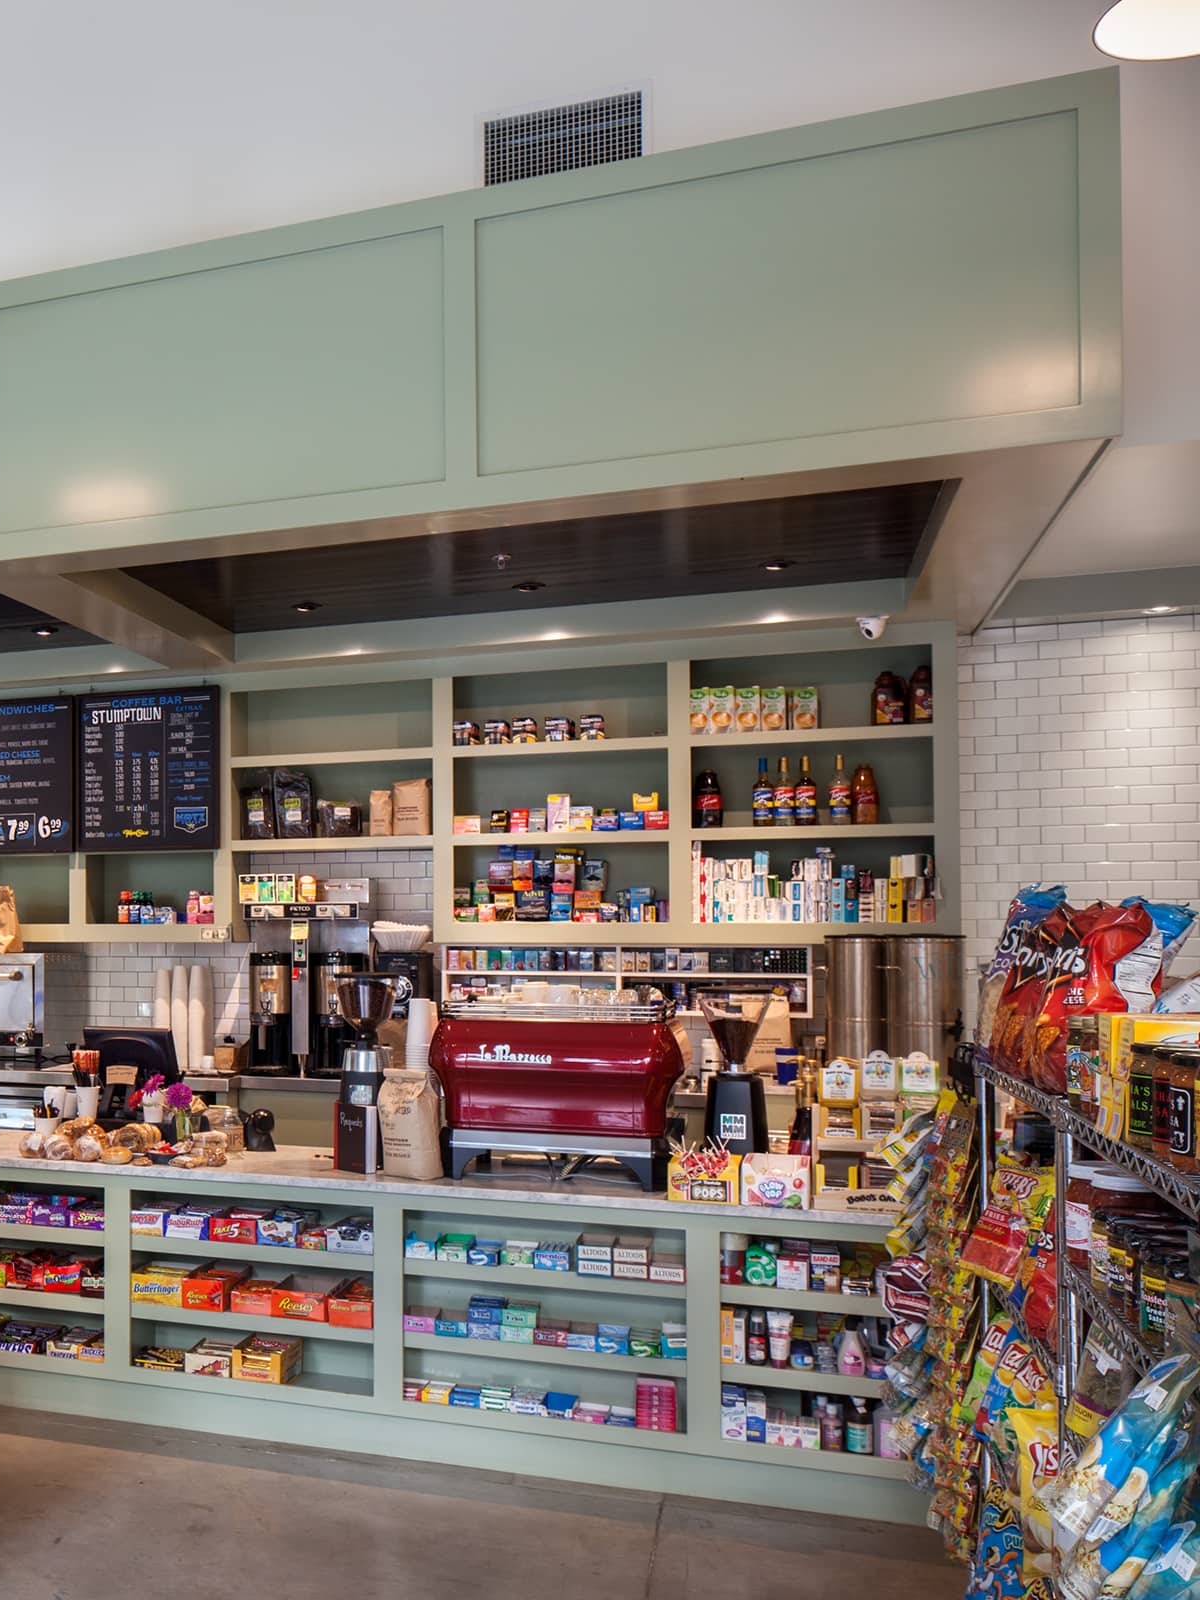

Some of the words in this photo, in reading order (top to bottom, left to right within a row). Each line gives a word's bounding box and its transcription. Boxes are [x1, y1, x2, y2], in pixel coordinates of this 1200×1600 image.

[112, 697, 155, 707] COFFEE
[159, 696, 182, 704] BAR
[92, 706, 162, 725] STUMPTOWN
[11, 750, 40, 759] CHEESE
[493, 1044, 553, 1064] Marzocco
[760, 1180, 785, 1192] BLOW
[694, 1187, 725, 1200] POPS
[766, 1189, 784, 1200] POP
[213, 1226, 231, 1236] TAKE
[231, 1222, 241, 1237] 5
[535, 1252, 568, 1261] mentos
[581, 1248, 609, 1257] ALTOIDS
[617, 1250, 645, 1260] ALTOIDS
[581, 1263, 609, 1272] ALTOIDS
[617, 1266, 645, 1276] ALTOIDS
[653, 1269, 682, 1279] ALTOIDS
[134, 1284, 180, 1295] Butterfinger
[278, 1296, 315, 1312] Reese's
[1148, 1313, 1164, 1323] Sals
